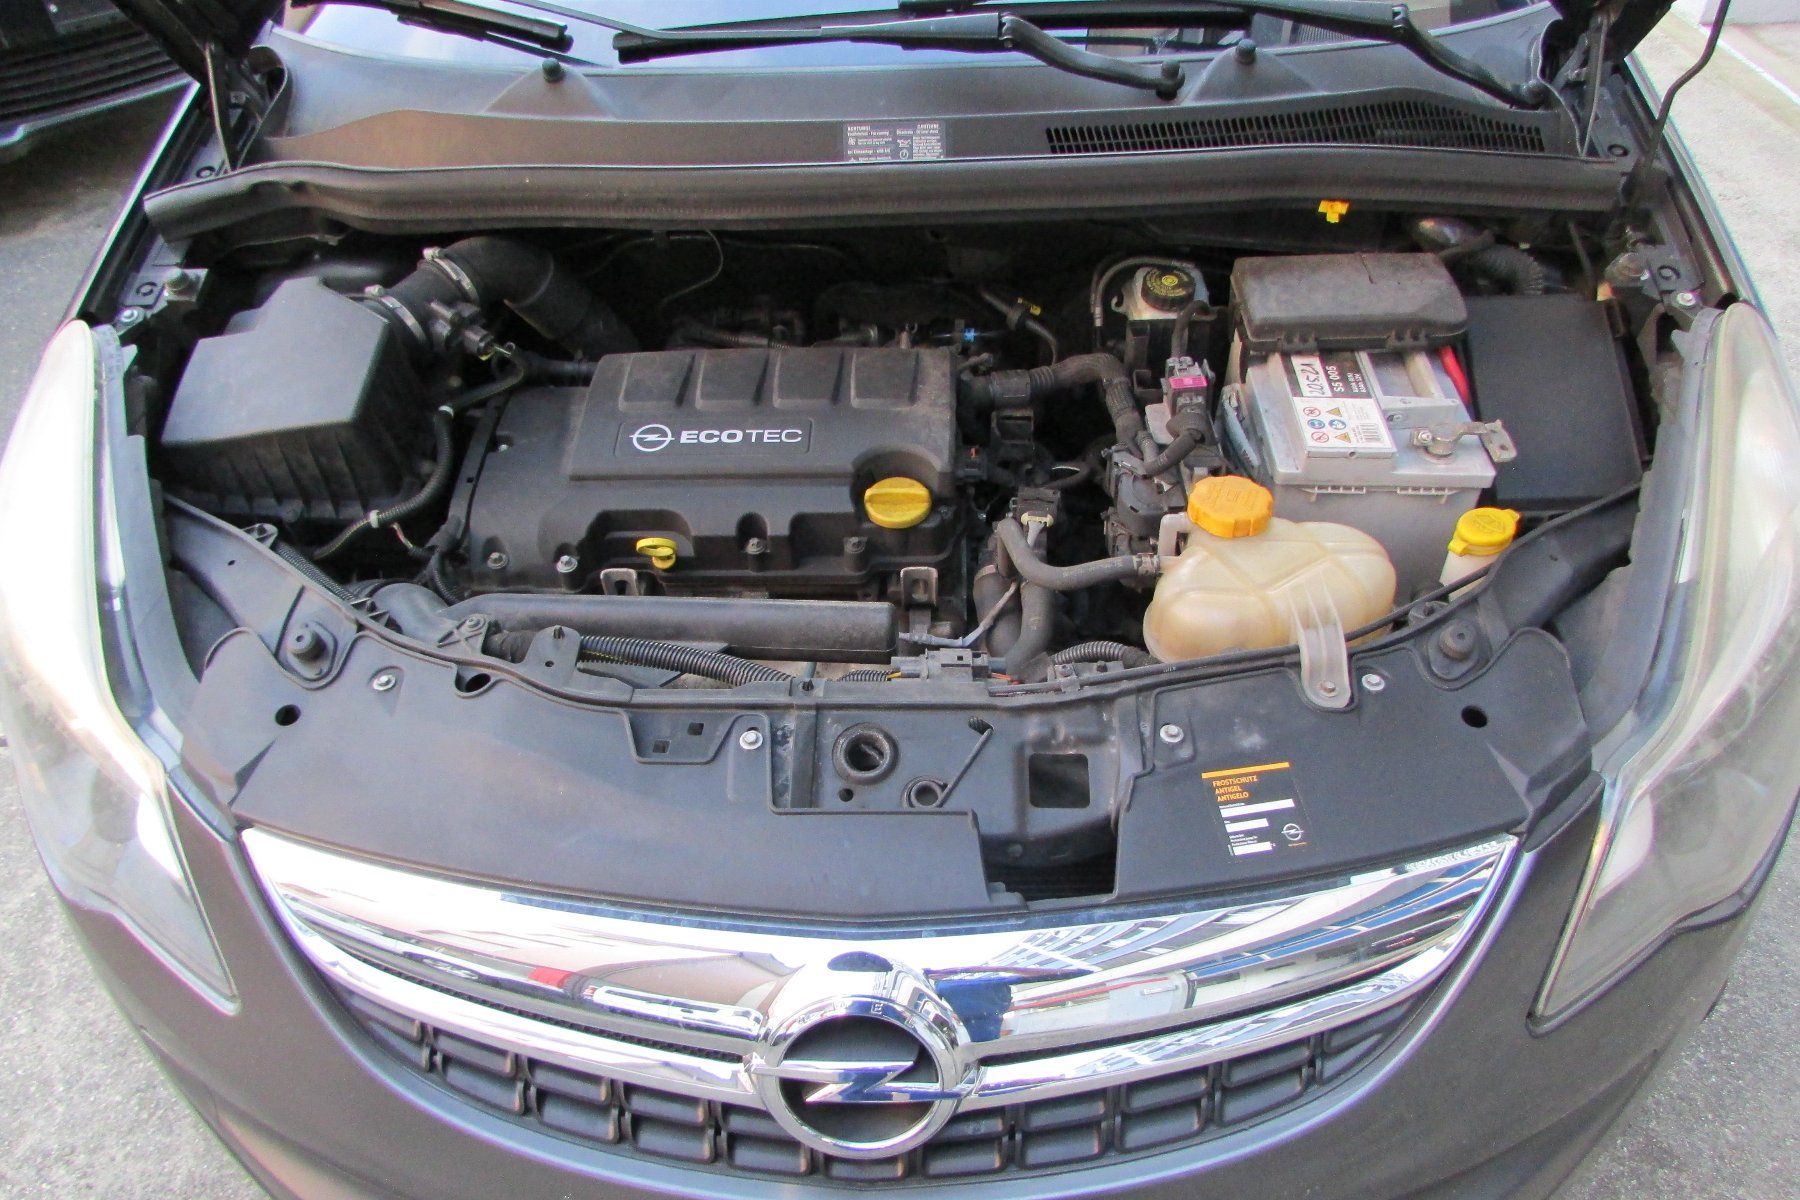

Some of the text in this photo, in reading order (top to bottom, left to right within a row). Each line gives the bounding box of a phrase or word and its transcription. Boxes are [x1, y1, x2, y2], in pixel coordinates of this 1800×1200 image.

[680, 429, 803, 444] ECOTEC
[1213, 775, 1258, 787] FROSTSCHUTZ
[1215, 785, 1242, 794] ANTIGEL
[1217, 792, 1249, 802] ANTIGELO
